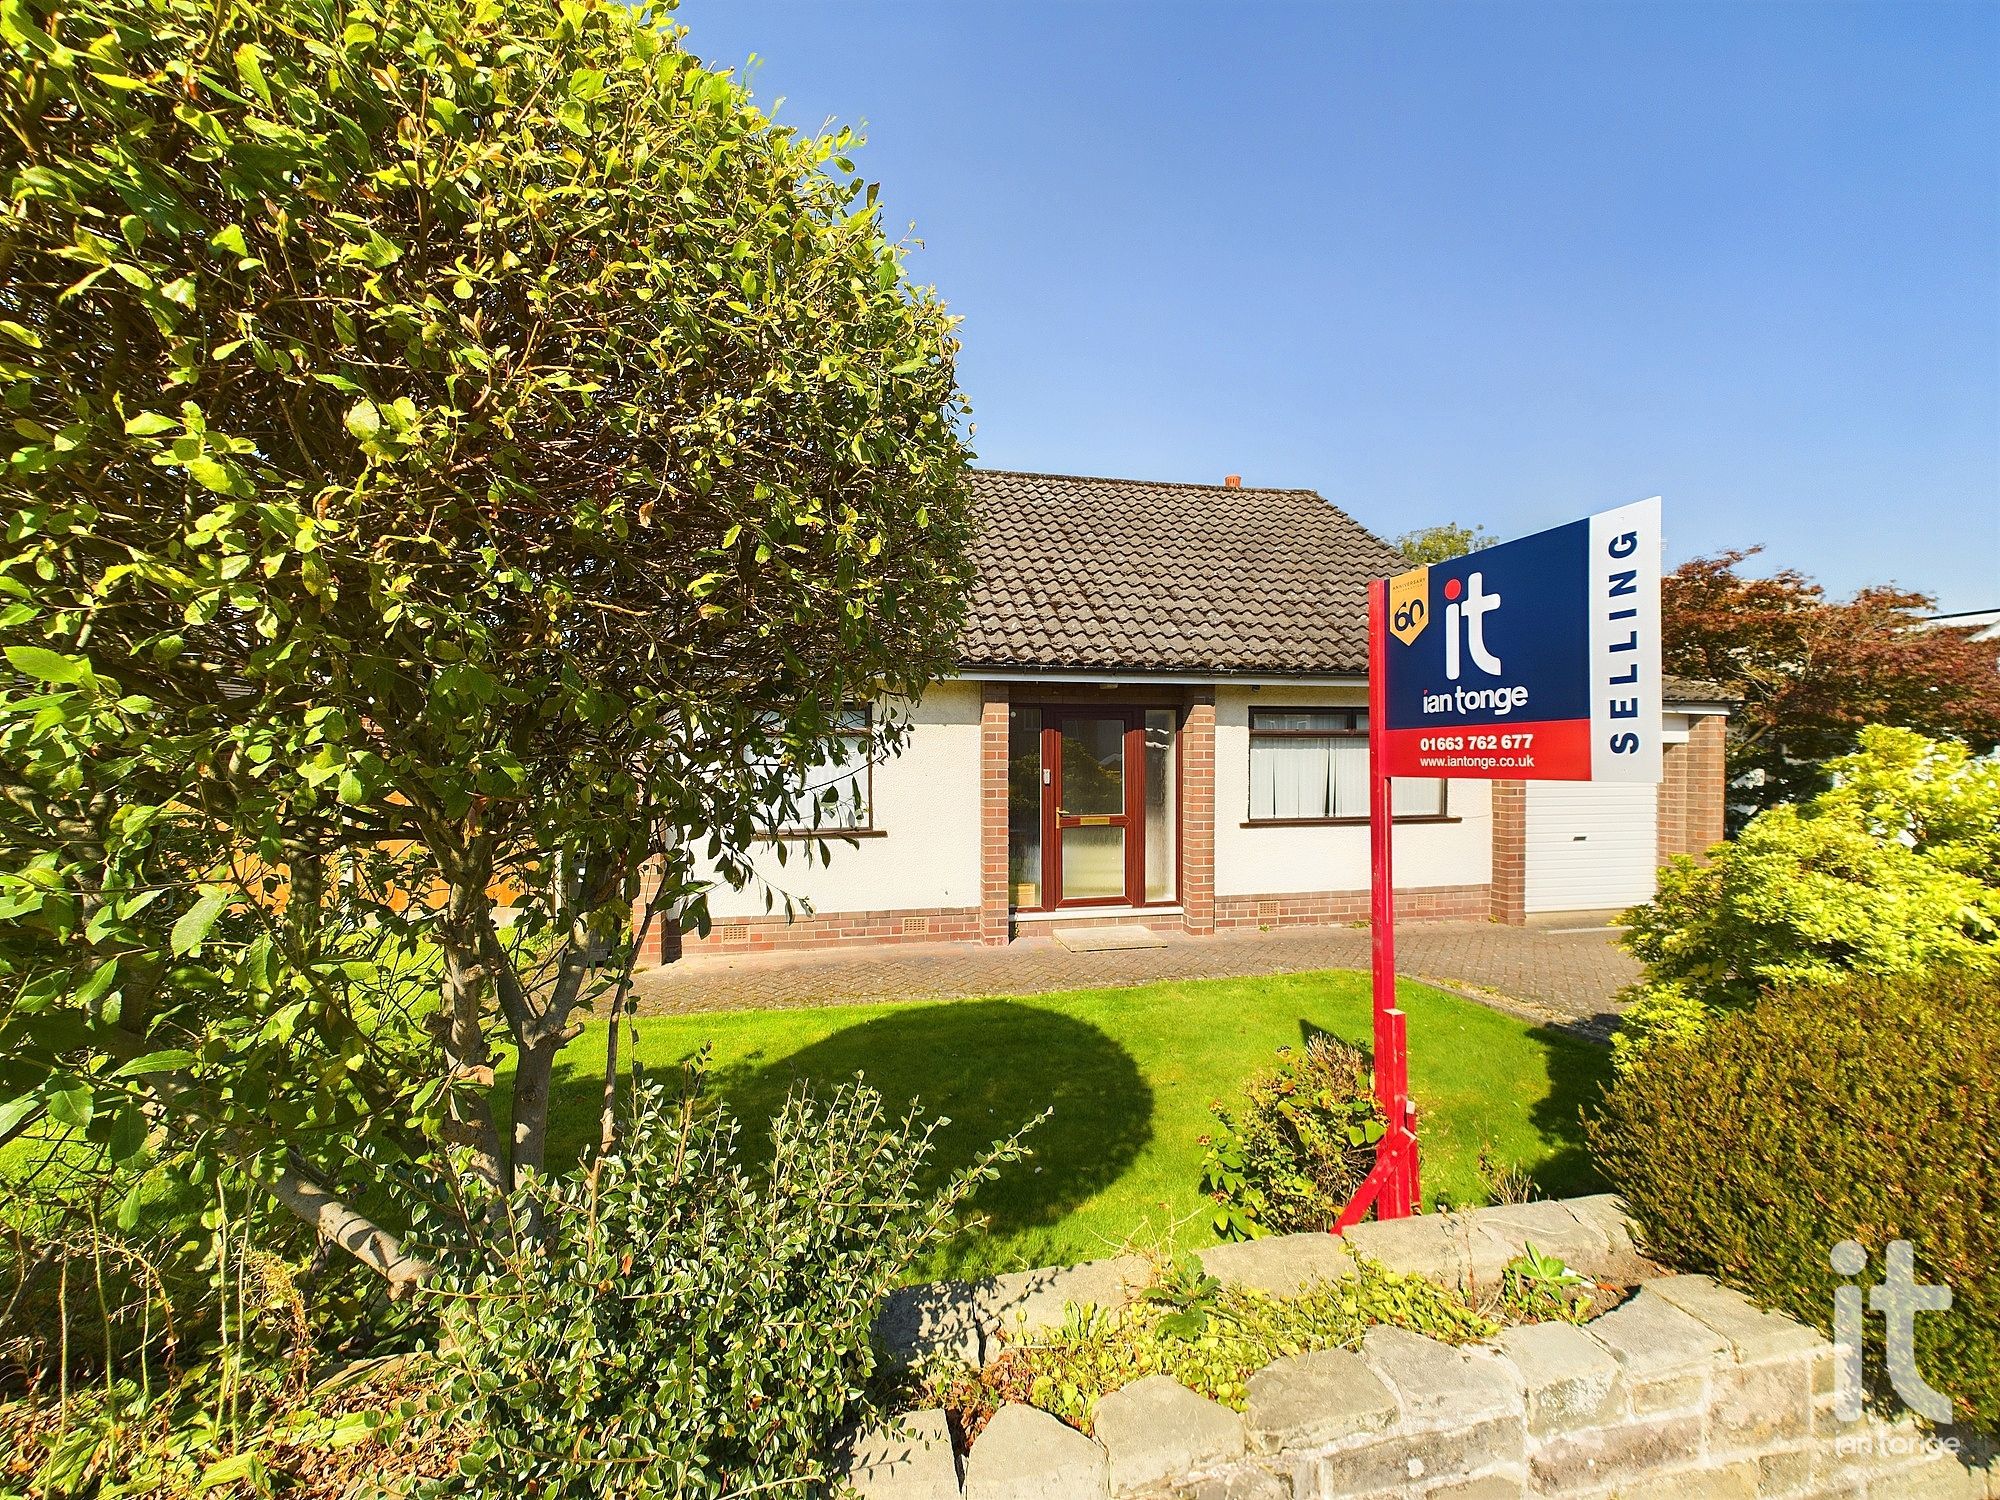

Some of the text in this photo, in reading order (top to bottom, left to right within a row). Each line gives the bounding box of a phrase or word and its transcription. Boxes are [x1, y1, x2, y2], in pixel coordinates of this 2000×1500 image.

[1394, 598, 1425, 632] 60
[1443, 571, 1502, 680] it
[1608, 530, 1640, 755] SELLING
[1423, 685, 1529, 715] ian tonge
[1420, 733, 1534, 752] 01663 762 677
[1420, 754, 1535, 770] www.iantonge.co.uk
